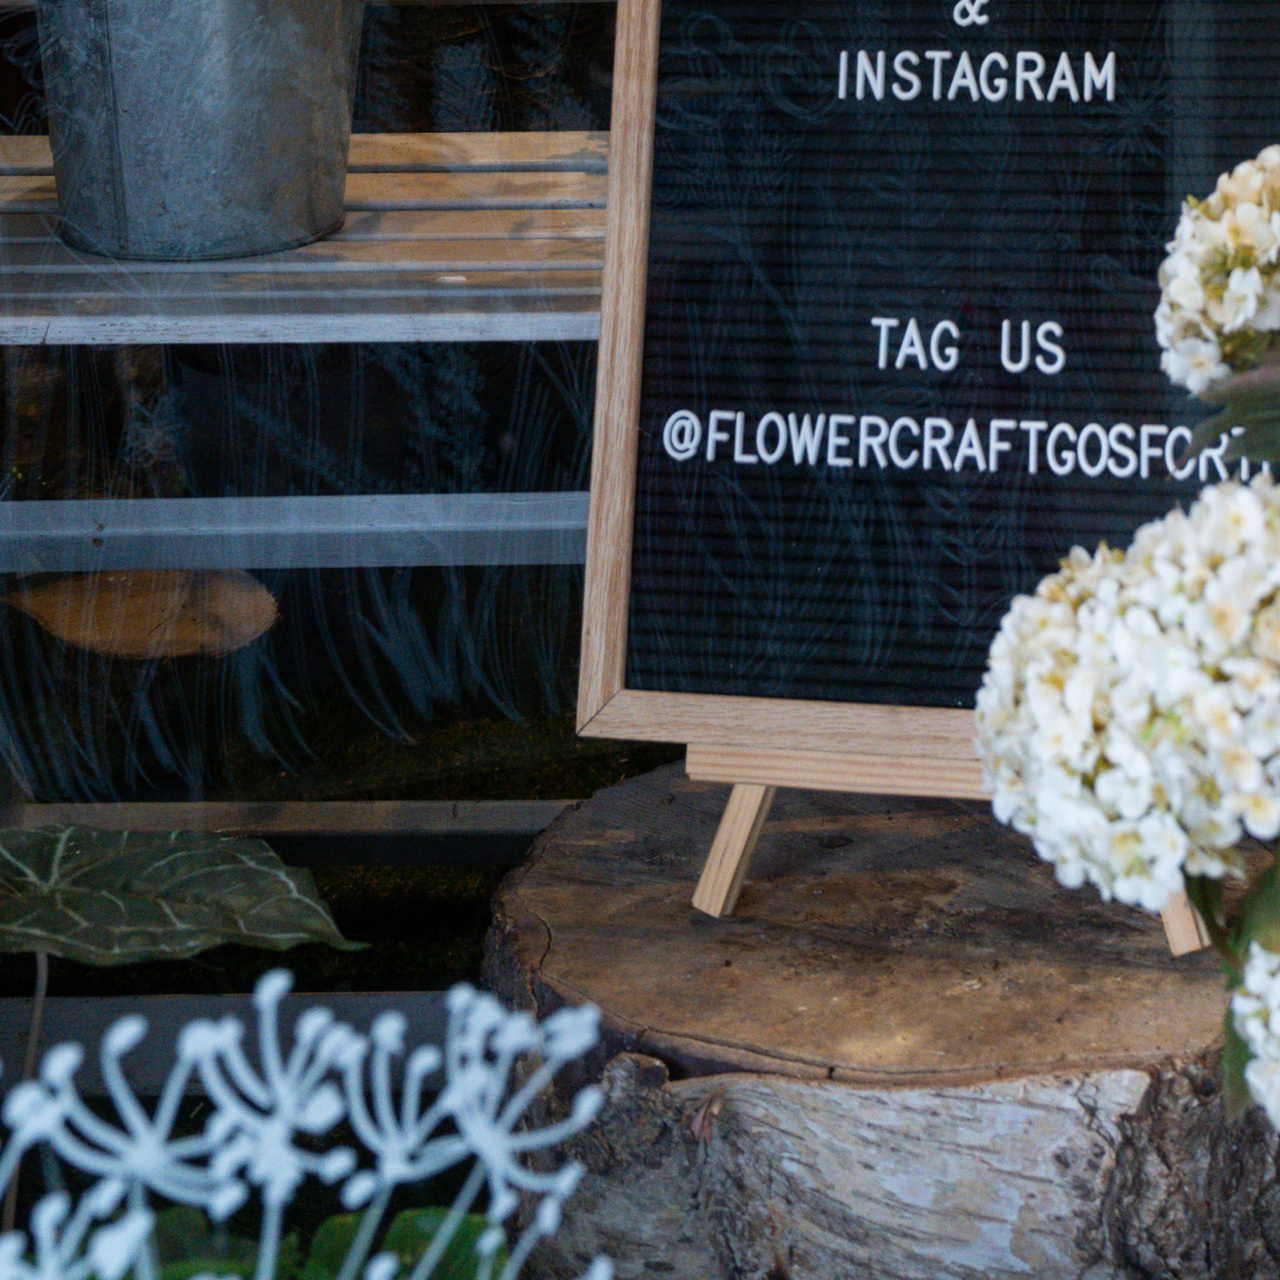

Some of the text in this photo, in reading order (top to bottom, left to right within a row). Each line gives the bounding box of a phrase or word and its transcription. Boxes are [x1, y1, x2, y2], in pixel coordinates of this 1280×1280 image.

[837, 49, 1116, 103] INSTAGRAM
[870, 316, 1066, 375] TAG US
